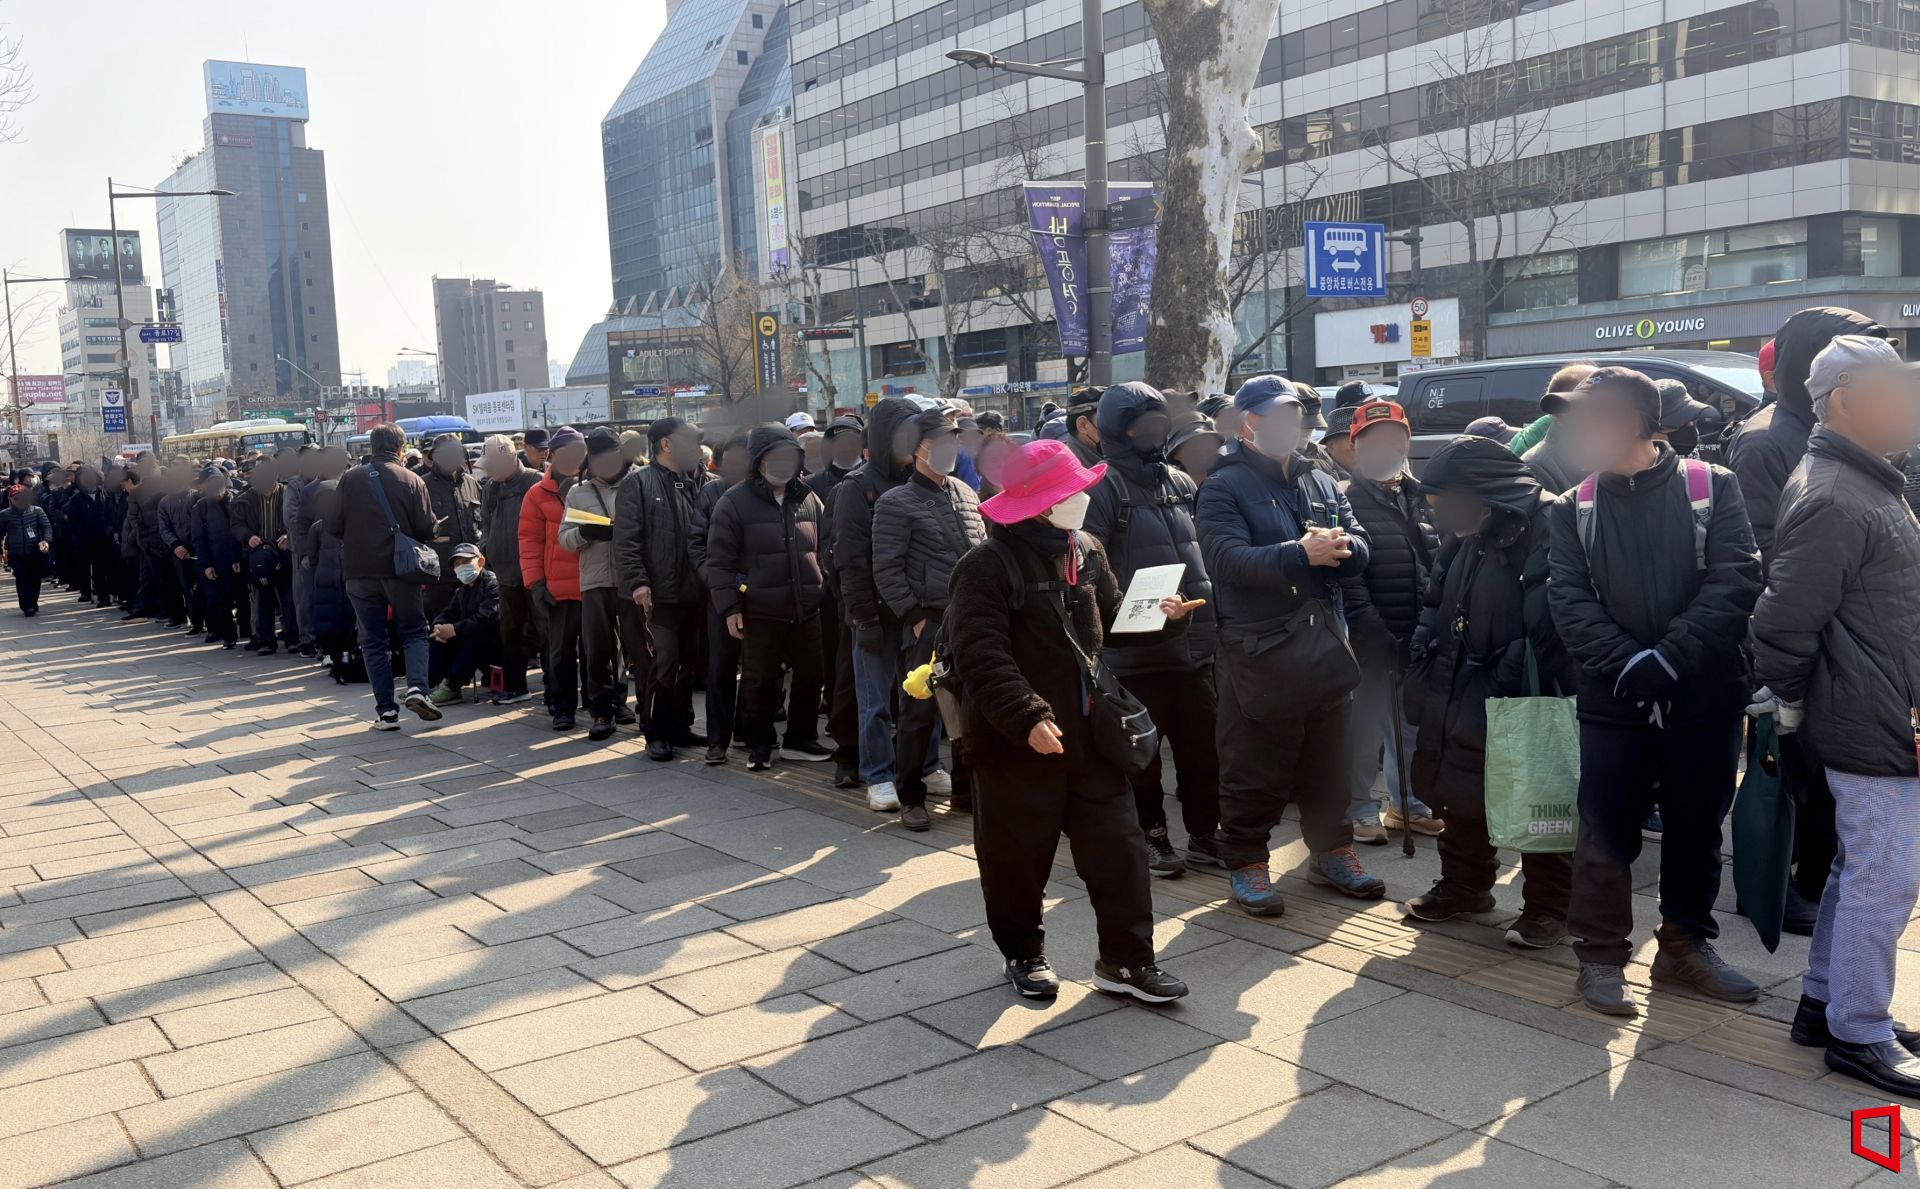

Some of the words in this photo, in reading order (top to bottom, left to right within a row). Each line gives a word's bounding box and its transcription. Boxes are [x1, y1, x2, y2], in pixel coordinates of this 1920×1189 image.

[1319, 276, 1374, 291] 중앙차로버스전용
[1414, 302, 1426, 312] 50
[1902, 304, 1920, 317] OLIV
[1595, 324, 1634, 339] OLIVE
[1656, 317, 1705, 333] YOUNG
[639, 349, 663, 358] ADULT
[992, 383, 1007, 394] IBK
[1007, 381, 1032, 393] 기업은행
[1527, 803, 1572, 818] THINK
[1528, 820, 1573, 834] GREEN
